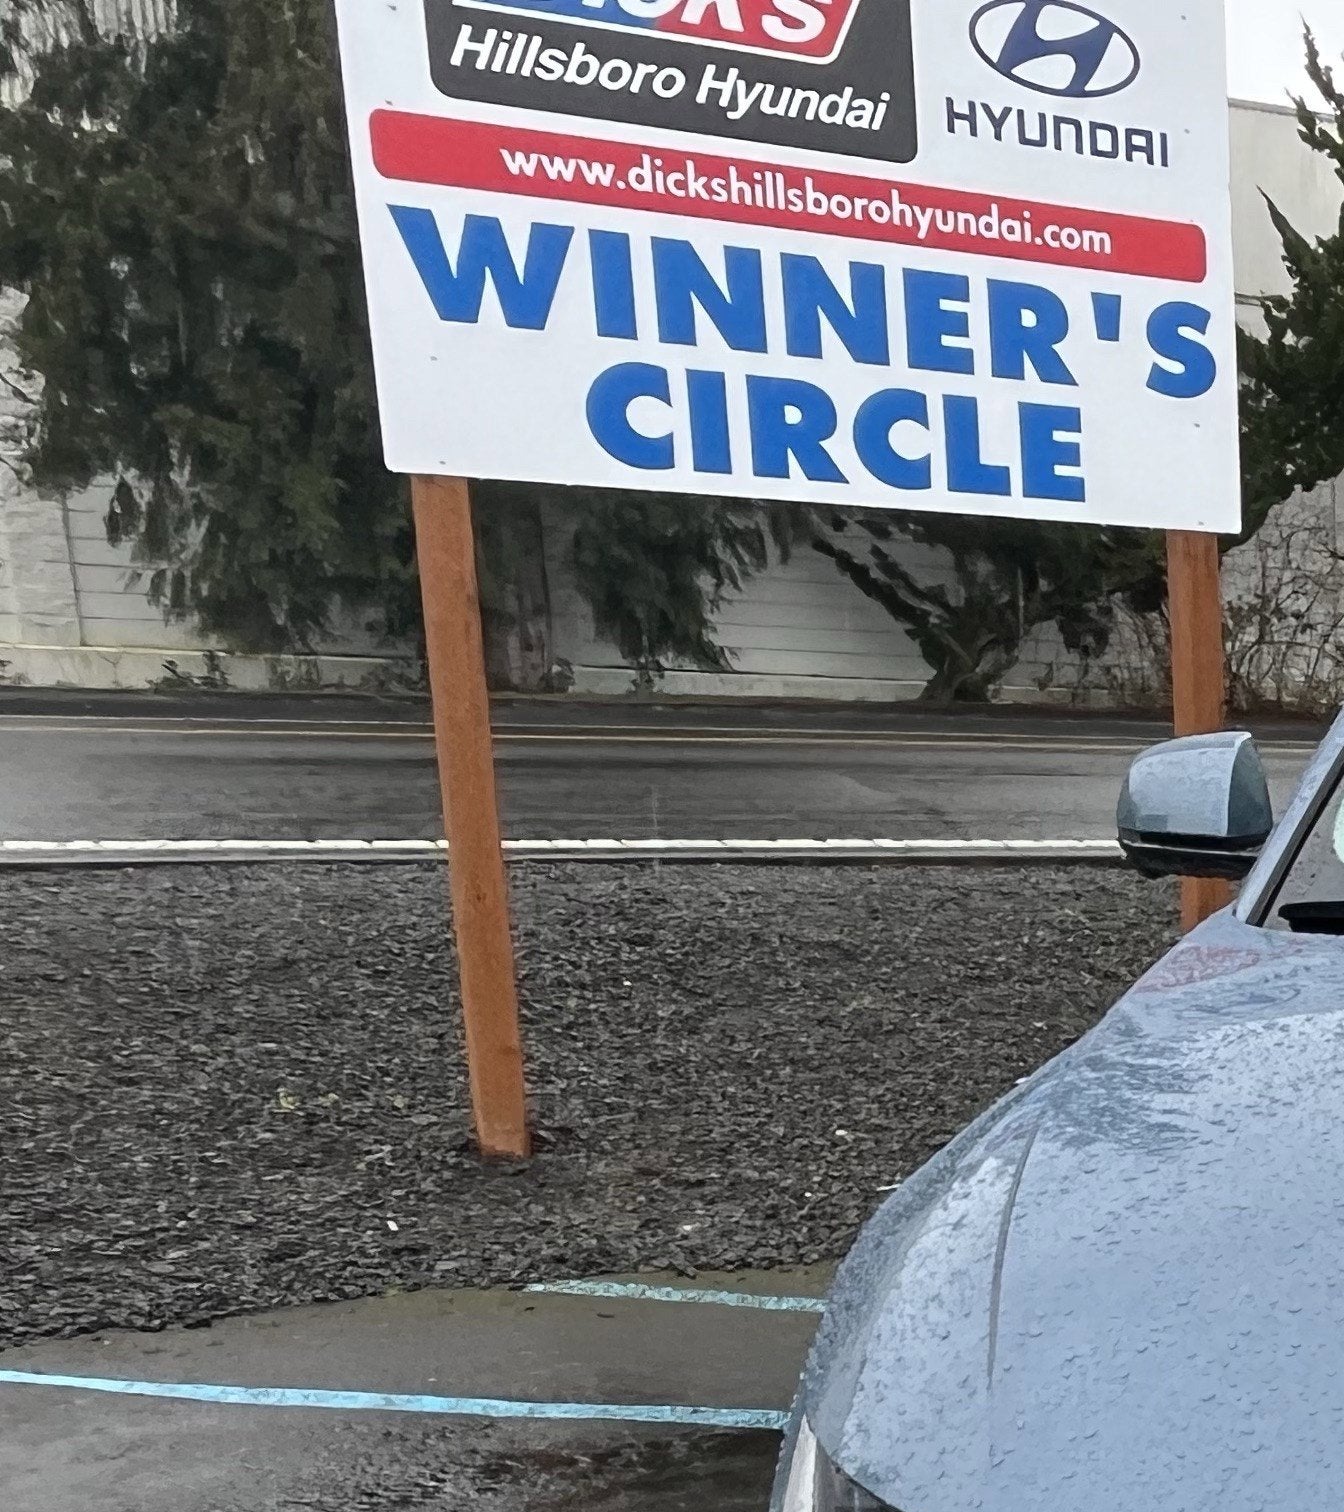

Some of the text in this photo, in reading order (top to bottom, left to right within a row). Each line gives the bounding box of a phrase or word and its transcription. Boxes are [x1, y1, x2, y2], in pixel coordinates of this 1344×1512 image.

[450, 24, 890, 132] Hillsboro Hyundai
[945, 96, 1169, 168] HYUNDAI
[500, 148, 1111, 255] www.dickshillsborohyundai.com
[388, 204, 1217, 400] WINNER'S
[586, 361, 1086, 503] CIRCLE
